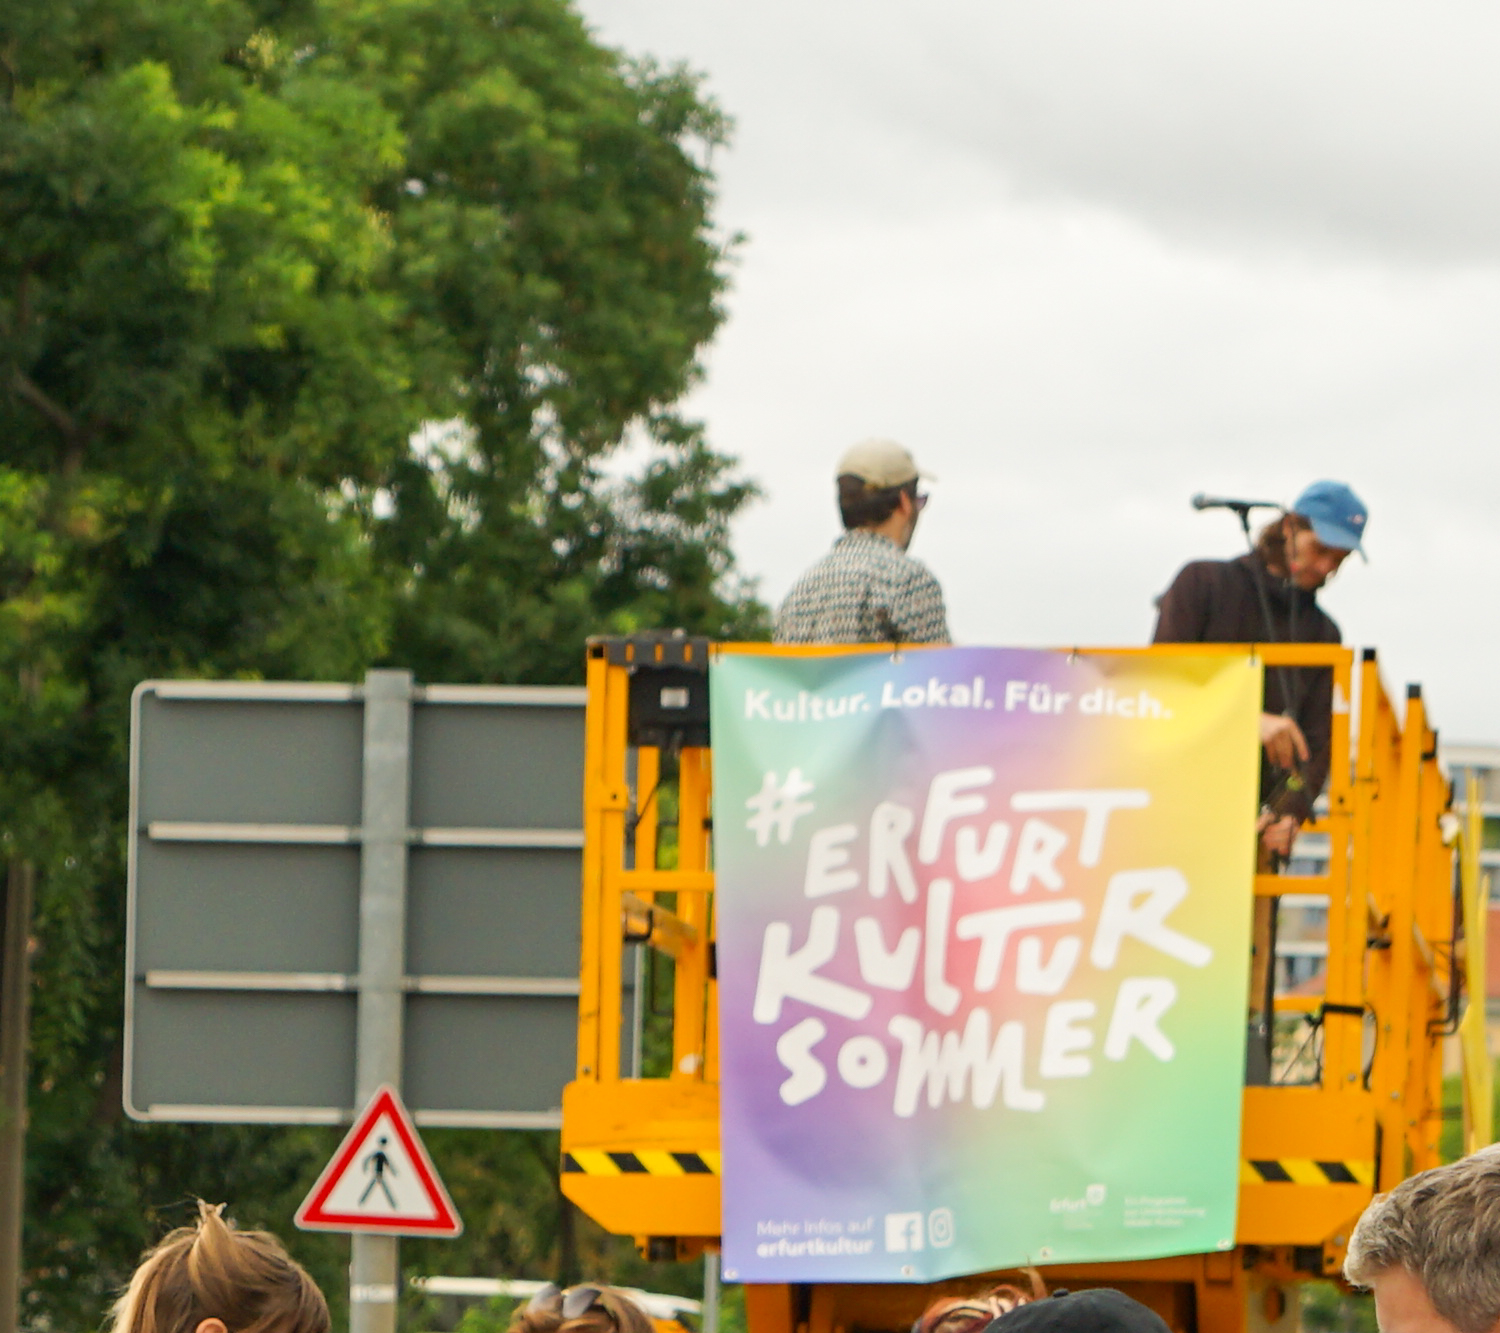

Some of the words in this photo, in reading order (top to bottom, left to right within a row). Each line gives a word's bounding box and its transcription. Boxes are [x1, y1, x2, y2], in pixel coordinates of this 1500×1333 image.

[744, 688, 871, 722] Kultur.
[881, 677, 994, 711] Lokal.
[1004, 681, 1068, 713] Für
[1078, 686, 1174, 720] dich.
[753, 867, 1212, 1024] KULTUR
[756, 1237, 875, 1258] erfurtkultur
